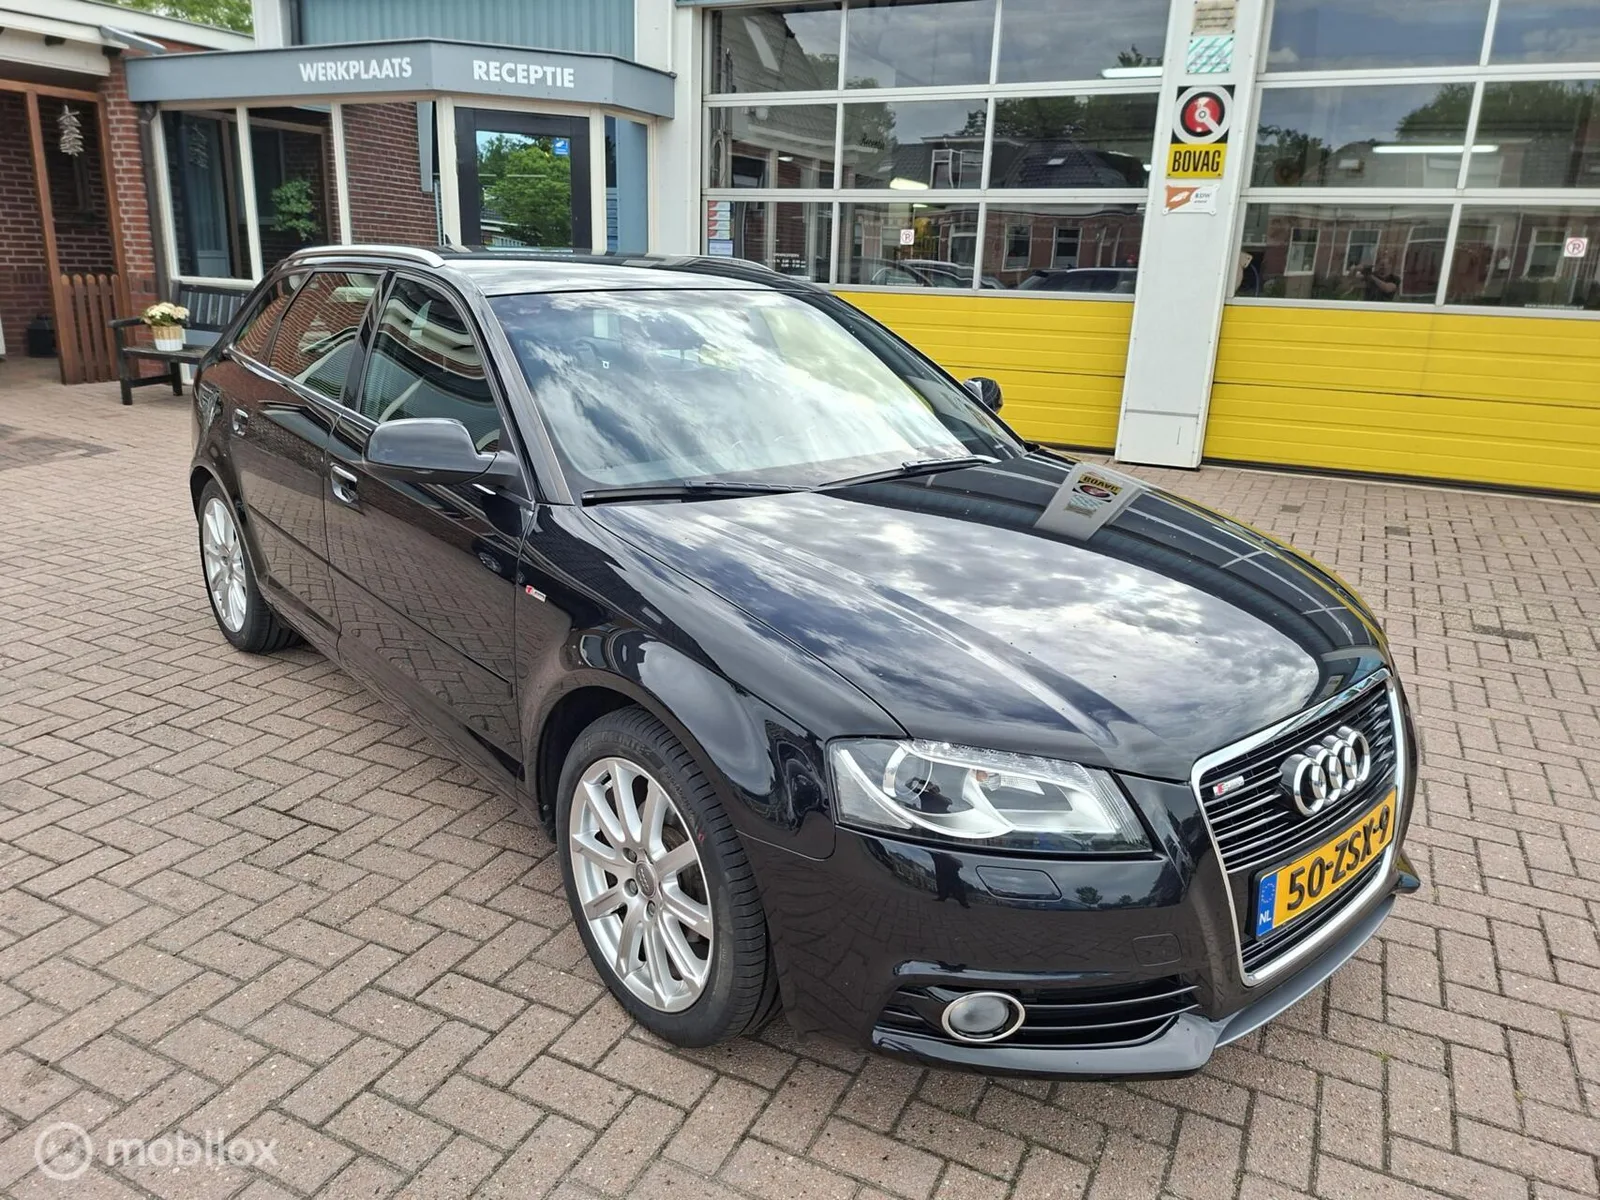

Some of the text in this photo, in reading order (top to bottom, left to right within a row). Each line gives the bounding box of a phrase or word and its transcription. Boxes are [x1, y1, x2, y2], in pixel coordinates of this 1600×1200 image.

[299, 57, 412, 82] WERKPLAATS
[473, 59, 575, 88] RECEPTIE
[1171, 150, 1221, 173] BOVAG
[1287, 804, 1391, 911] 50-ZSX-9
[1259, 909, 1272, 925] NL
